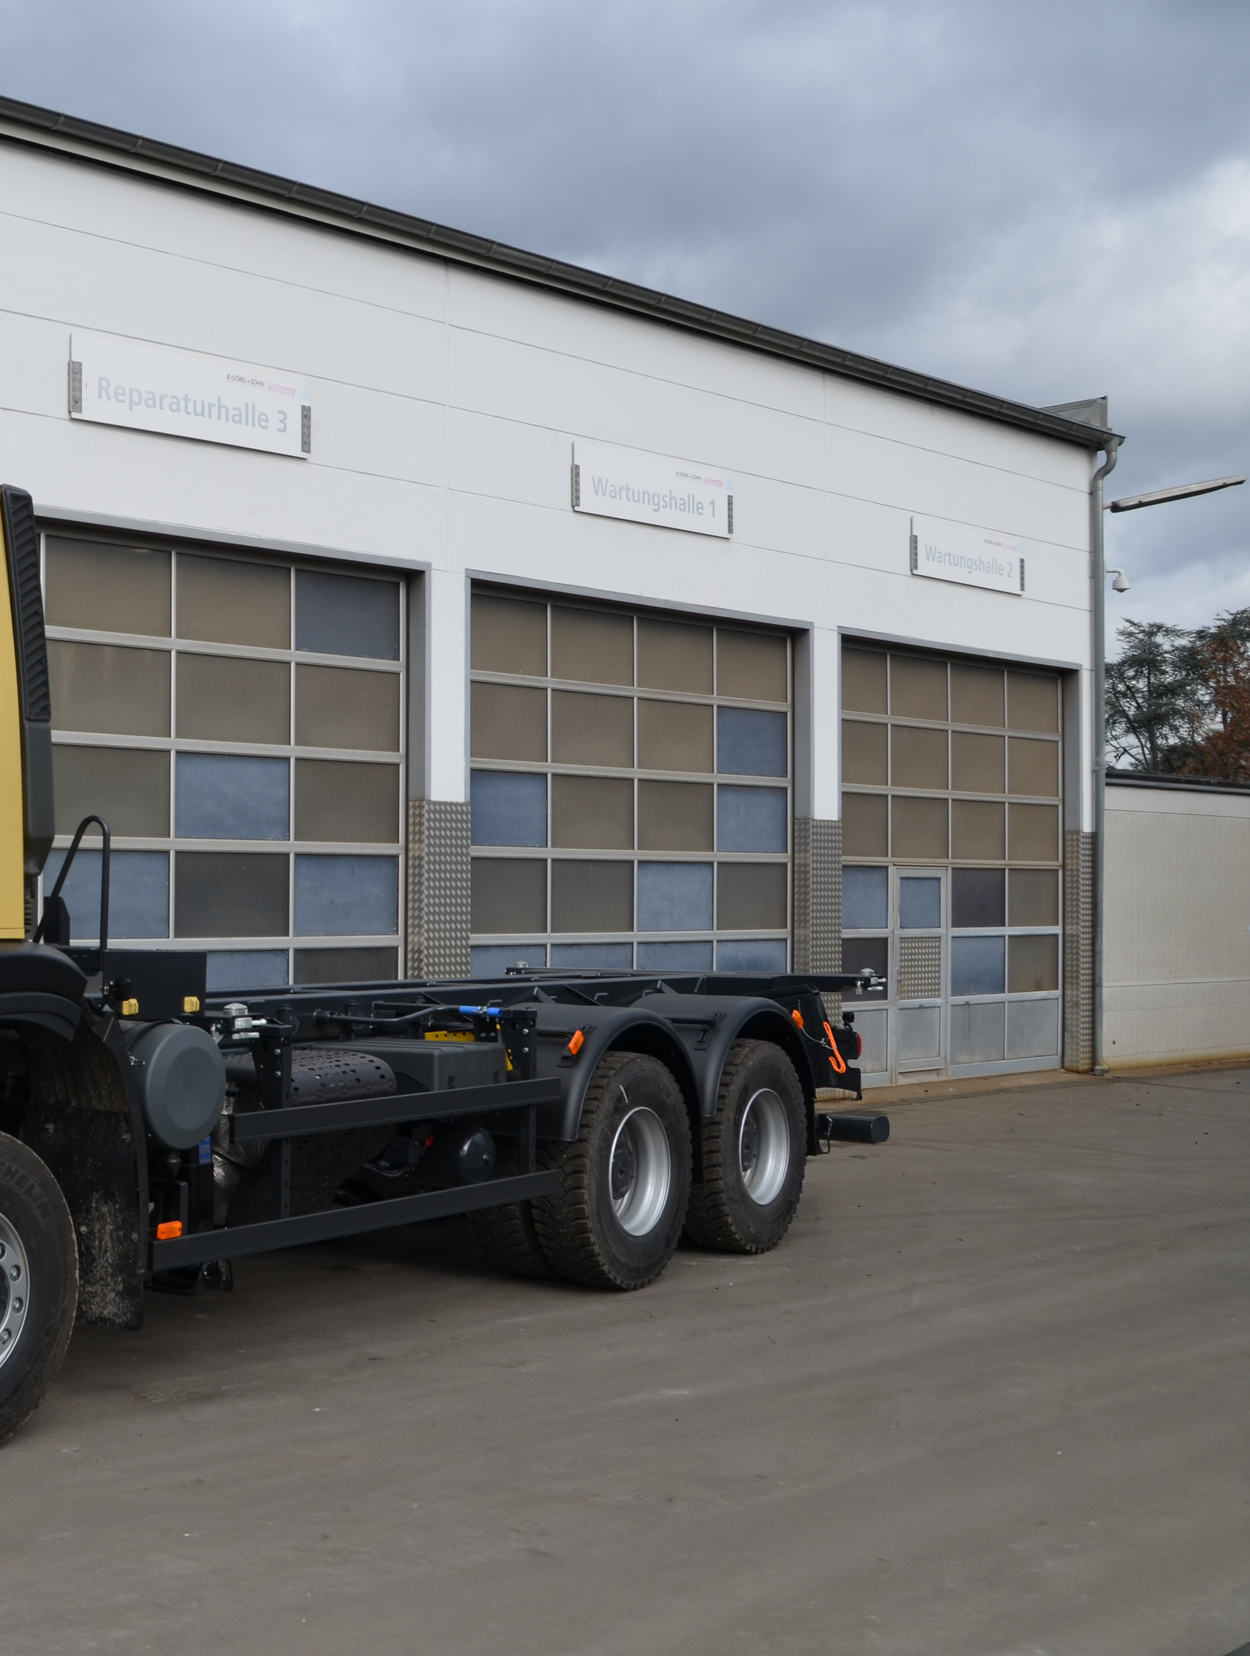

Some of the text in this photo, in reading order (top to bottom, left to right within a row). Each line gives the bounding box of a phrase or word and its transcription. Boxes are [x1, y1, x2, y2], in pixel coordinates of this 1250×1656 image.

[97, 376, 288, 433] Reparaturhalle 3
[591, 475, 716, 518] Wartungshalle 1
[924, 544, 1014, 578] Wartungshalle 2
